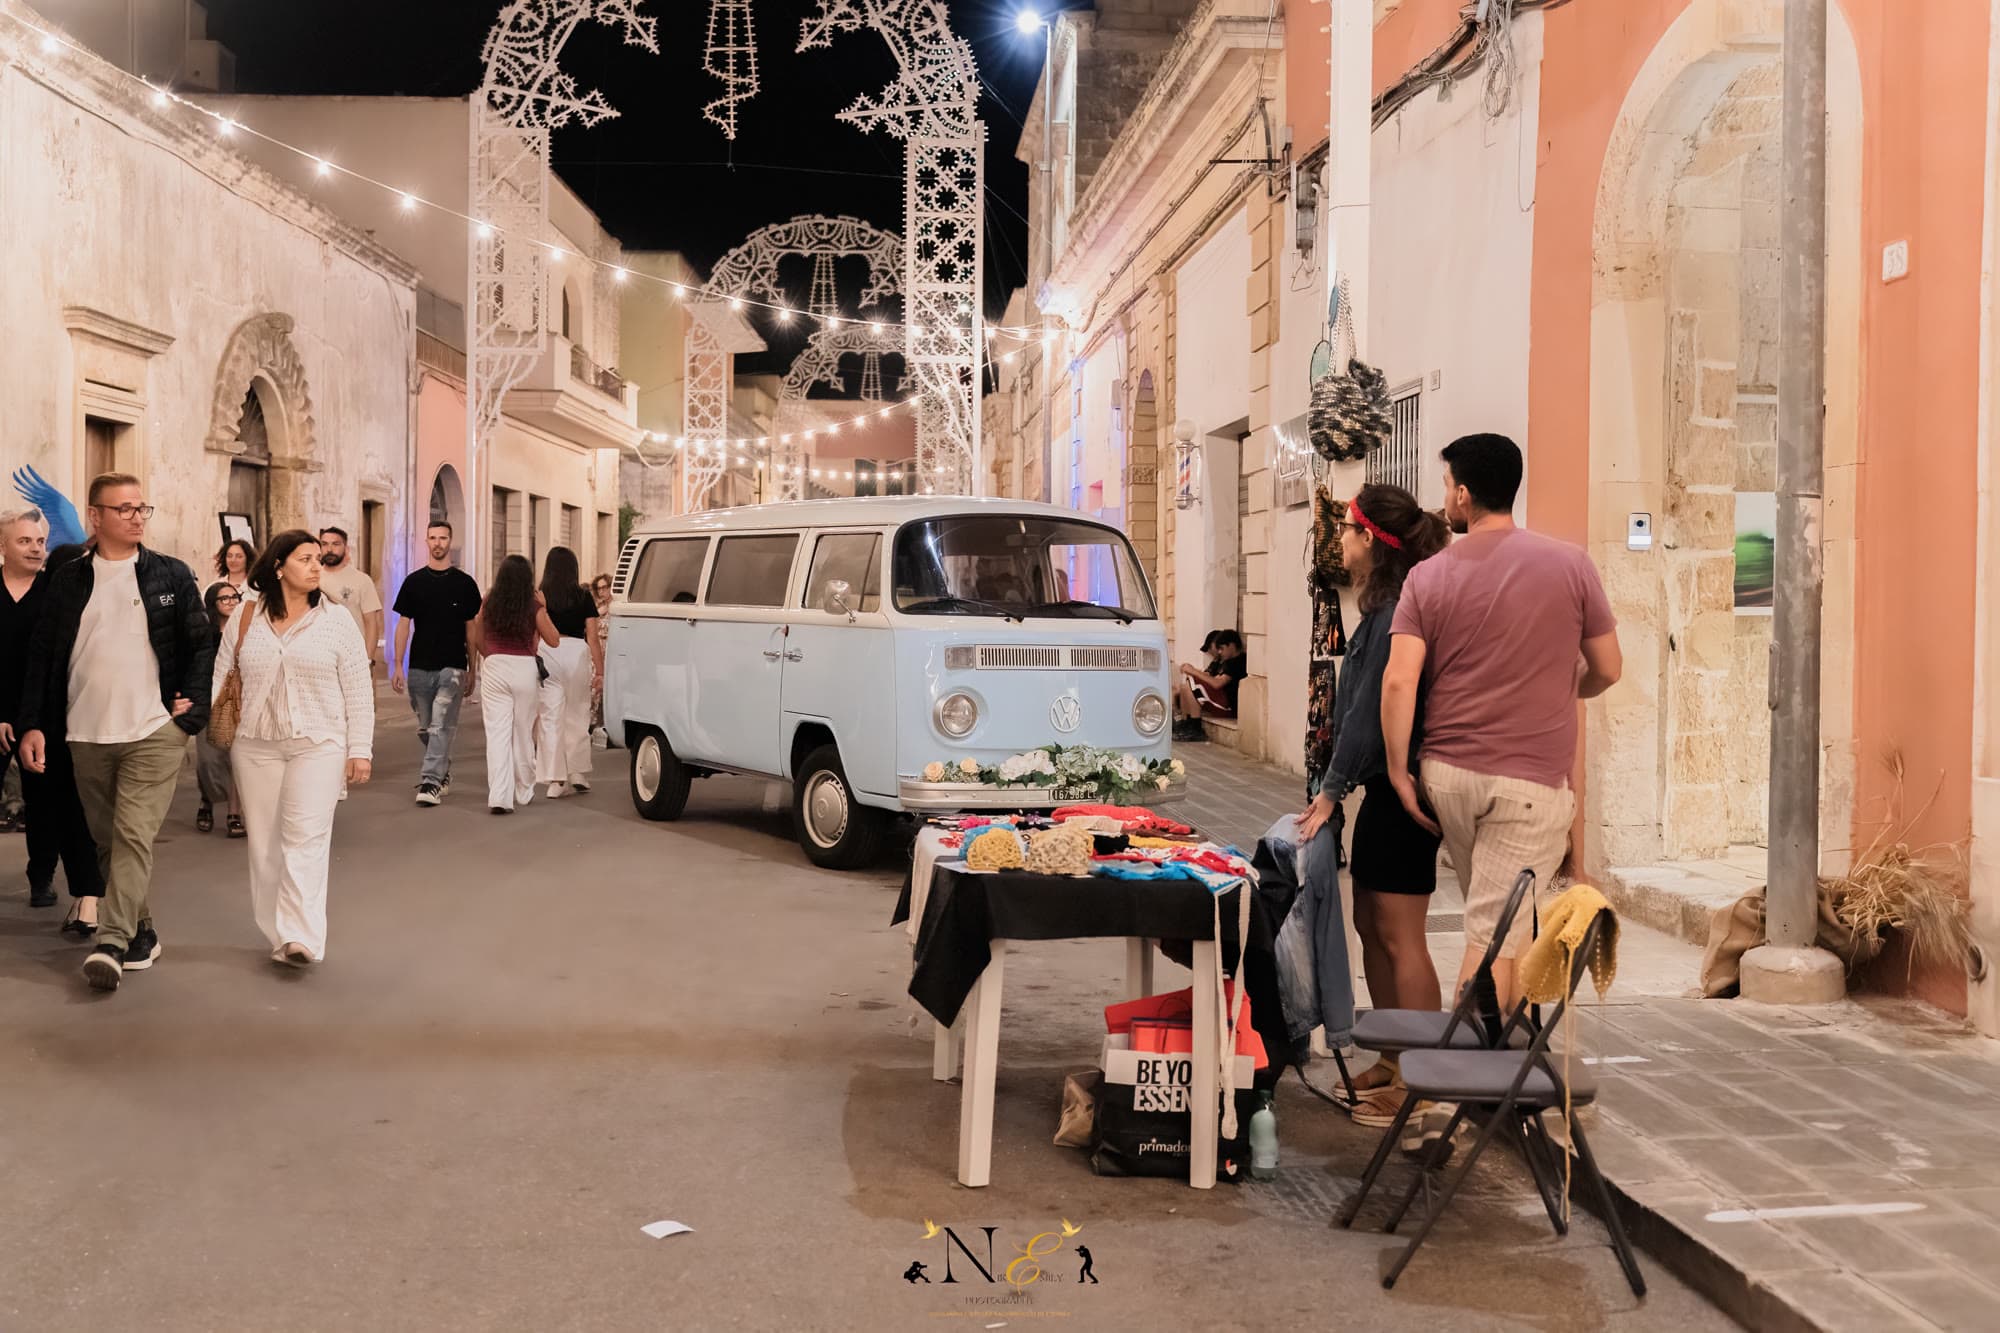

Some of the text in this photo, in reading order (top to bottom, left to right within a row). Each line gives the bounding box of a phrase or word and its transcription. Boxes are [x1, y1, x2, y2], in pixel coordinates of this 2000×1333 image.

[1137, 1060, 1192, 1085] BE YO
[1133, 1086, 1192, 1112] ESSEN
[1139, 1138, 1191, 1156] primado
